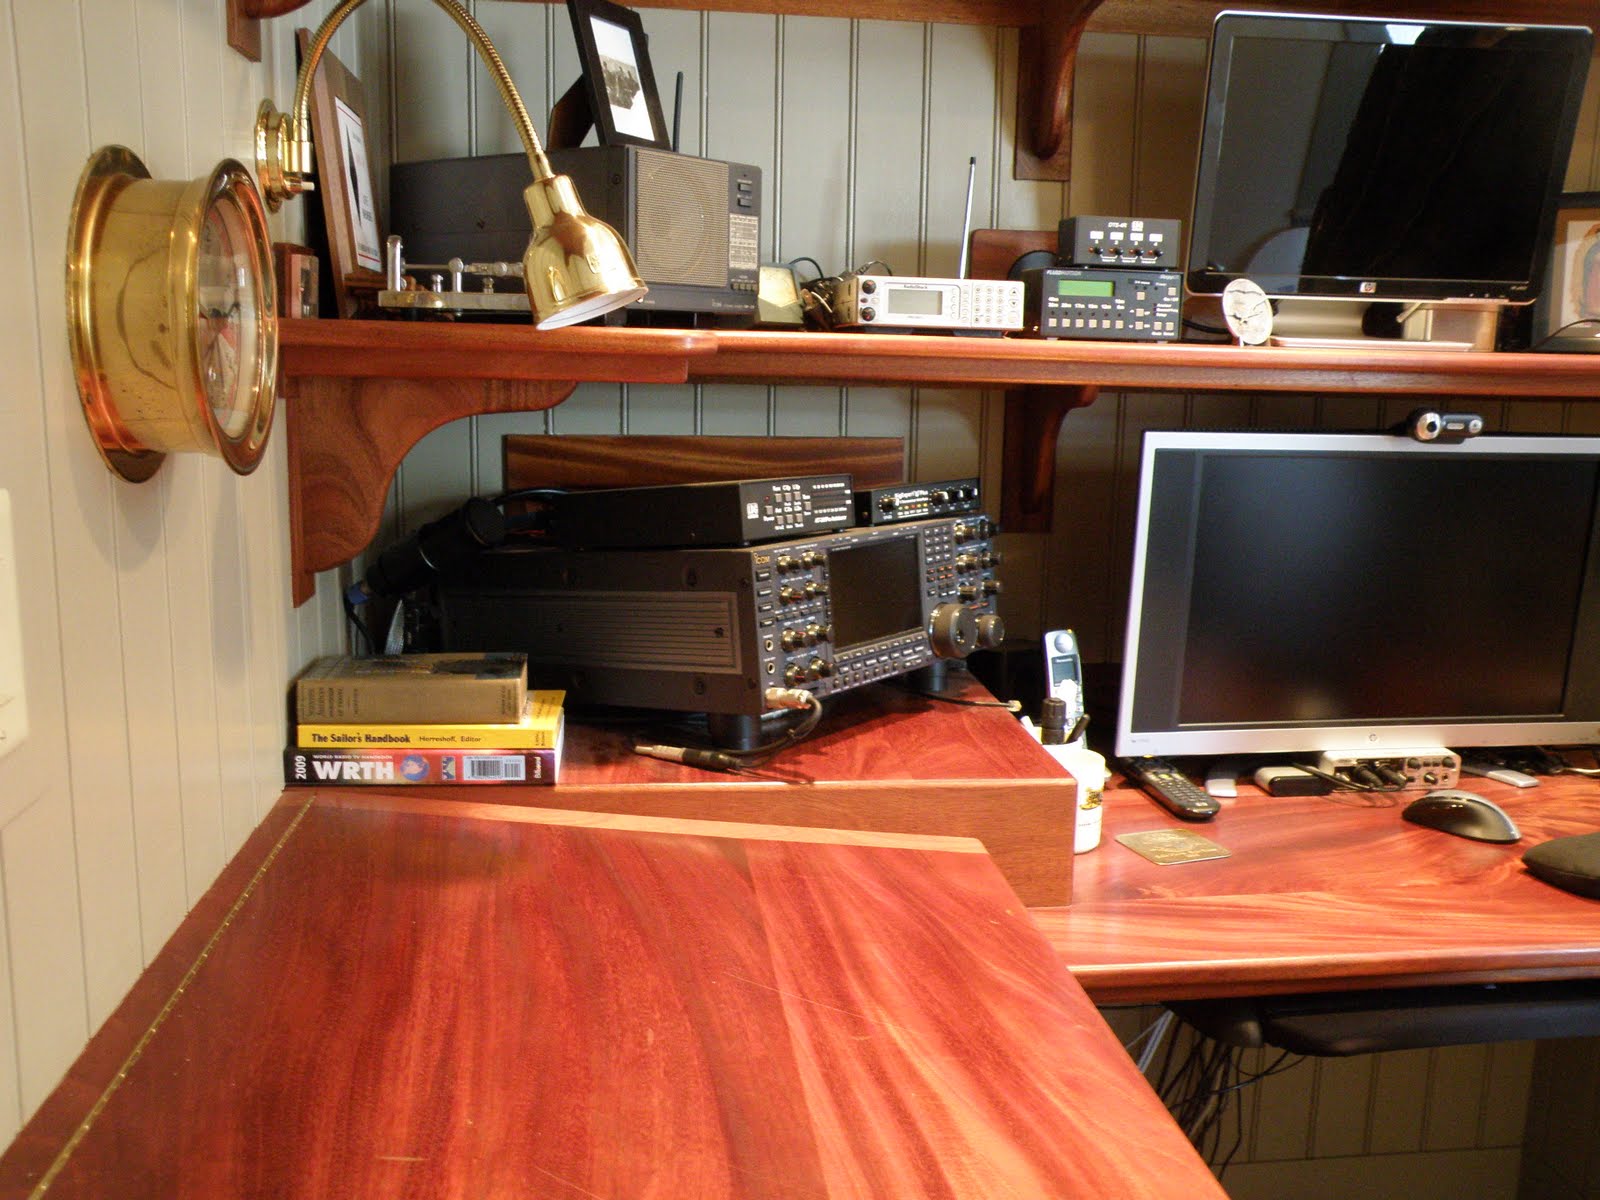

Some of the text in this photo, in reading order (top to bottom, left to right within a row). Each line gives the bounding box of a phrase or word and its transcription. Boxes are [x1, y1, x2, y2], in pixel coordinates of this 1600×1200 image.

[312, 733, 328, 743] The
[330, 732, 362, 743] Sailor's
[365, 733, 411, 743] Handbook
[295, 755, 306, 780] 2009
[312, 761, 394, 780] WRTH
